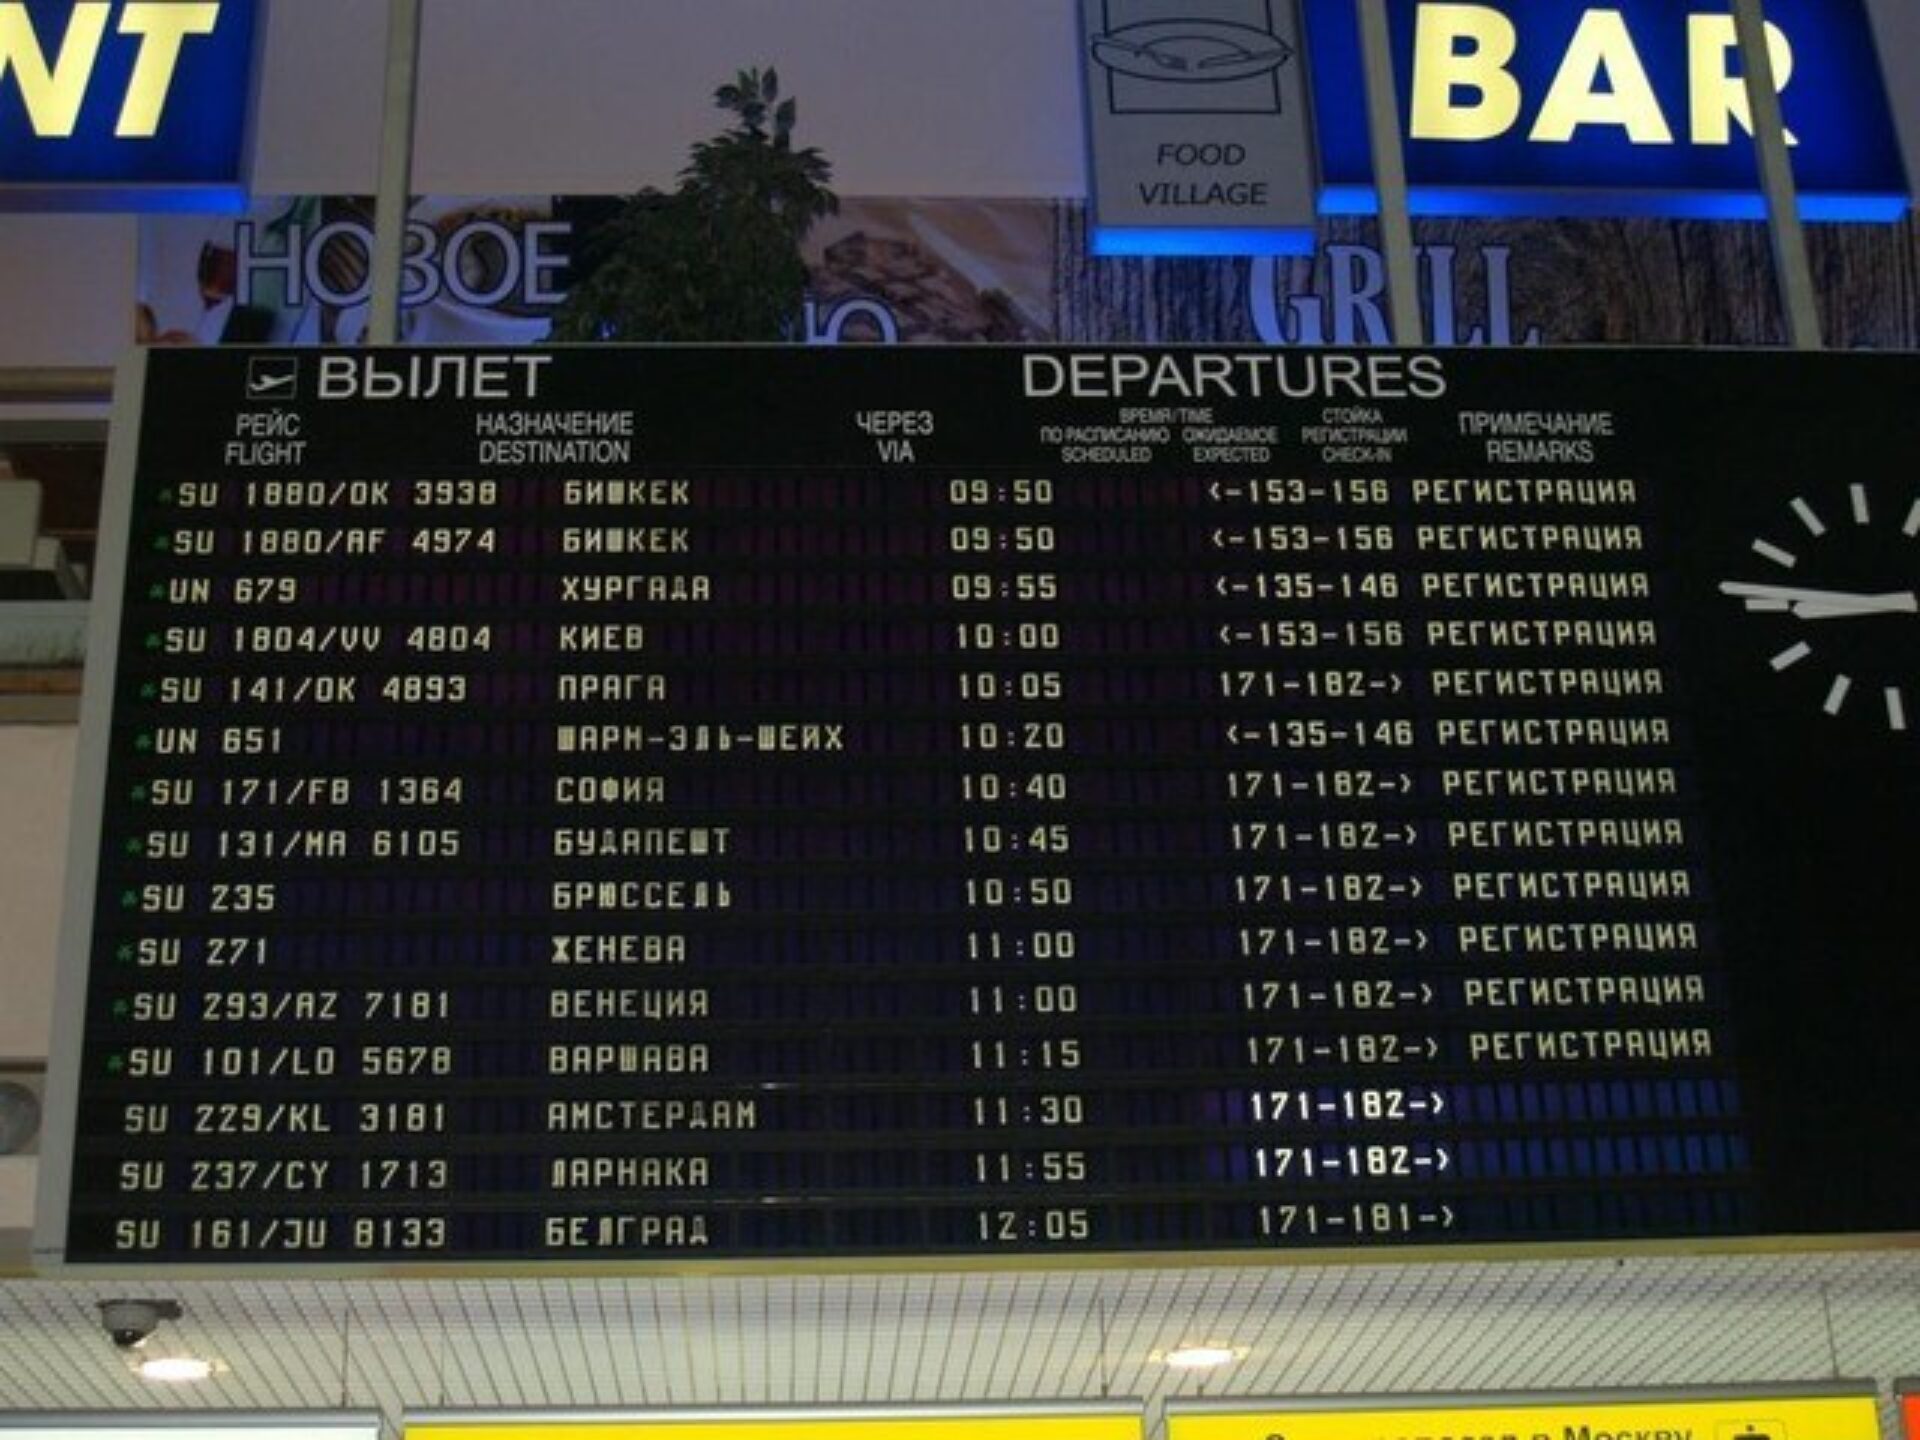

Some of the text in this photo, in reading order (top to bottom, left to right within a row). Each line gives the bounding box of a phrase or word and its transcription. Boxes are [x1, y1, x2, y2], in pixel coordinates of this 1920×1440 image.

[1410, 3, 1799, 145] BAR
[1157, 143, 1246, 166] FOOD
[1139, 182, 1268, 206] VILLAGE
[235, 222, 572, 305] НОВОЕ
[1249, 245, 1540, 345] GRLL
[317, 356, 552, 399] ВЫЛЕТ
[1023, 355, 1447, 398] DEPARTURES
[236, 409, 301, 437] РЕЙС
[476, 411, 635, 436] НАЗНАЧЕНИЕ
[856, 410, 934, 436] ЧЕРЕЗ
[1322, 406, 1383, 424] СТОЙКА
[1458, 411, 1615, 436] ПРИМЕЧАНИЕ
[1040, 426, 1063, 444] ПО
[225, 441, 306, 466] FLIGHT
[479, 440, 631, 464] DESTINATION
[877, 439, 916, 463] VIA
[1061, 447, 1153, 464] SCHEDULED
[1193, 447, 1271, 464] EXPECTED
[1322, 447, 1394, 464] CHECK-IN
[1486, 439, 1595, 464] REMARKS
[179, 480, 496, 506] SU 1880/OK 3938
[564, 480, 688, 505] БИШКЕК
[950, 479, 1052, 504] 09:50
[1412, 479, 1636, 505] РЕГИСТРАЦИЯ
[175, 528, 495, 554] SU 1880/AF 4974
[563, 527, 688, 553] БИШКЕК
[951, 527, 1055, 551] 09:50
[1417, 525, 1642, 551] РЕГИСТРАЦИЯ
[170, 577, 296, 603] UN 679
[562, 575, 709, 601] ХУРГАДА
[952, 574, 1057, 600] 09:55
[1422, 572, 1649, 599] РЕГИСТРАЦИЯ
[166, 626, 490, 652] SU 1804/VV 4804
[560, 625, 643, 650] КИЕВ
[958, 623, 1059, 649] 10:00
[1427, 620, 1656, 647] РЕГИСТРАЦИЯ
[161, 675, 466, 703] SU 141/OK 4893
[559, 674, 665, 701] ПРАГА
[960, 672, 1061, 699] 10:05
[1432, 669, 1662, 696] РЕГИСТРАЦИЯ
[156, 727, 280, 754] UN 651
[961, 723, 1064, 749] 10:20
[1438, 719, 1669, 746] РЕГИСТРАЦИЯ
[152, 777, 461, 805] SU 171/FB 1364
[556, 776, 664, 803] СОФИЯ
[963, 774, 1066, 800] 10:40
[1442, 768, 1675, 796] РЕГИСТРАЦИЯ
[147, 830, 458, 858] SU 131/MA 6105
[554, 828, 728, 856] БУДАПЕШТ
[965, 825, 1069, 853] 10:45
[1448, 819, 1683, 847] РЕГИСТРАЦИЯ
[143, 884, 275, 911] SU 235
[553, 881, 730, 910] БРЮССЕЛЬ
[967, 878, 1072, 905] 10:50
[1454, 870, 1690, 899] РЕГИСТРАЦИЯ
[552, 935, 685, 963] ЖЕНЕВА
[968, 931, 1075, 959] 11:00
[1459, 923, 1696, 952] РЕГИСТРАЦИЯ
[138, 938, 266, 965] SU 271
[551, 989, 708, 1019] ВЕНЕЦИЯ
[971, 986, 1076, 1013] 11:00
[1464, 975, 1704, 1006] РЕГИСТРАЦИЯ
[134, 991, 447, 1020] SU 293/AZ 7181
[973, 1040, 1080, 1069] 11:15
[1470, 1029, 1711, 1060] РЕГИСТРАЦИЯ
[129, 1046, 451, 1076] SU 101/LO 5678
[549, 1045, 708, 1073] ВАРШАВА
[126, 1103, 443, 1132] SU 229/KL 3181
[548, 1100, 755, 1130] АМСТЕРДАМ
[975, 1096, 1082, 1125] 11:30
[121, 1160, 447, 1190] SU 237/CY 1713
[551, 1157, 708, 1187] ЛАРНАКА
[977, 1152, 1085, 1182] 11:55
[116, 1218, 445, 1249] SU 161/JU 8133
[546, 1216, 708, 1246] БЕЛГРАД
[980, 1210, 1088, 1240] 12:05
